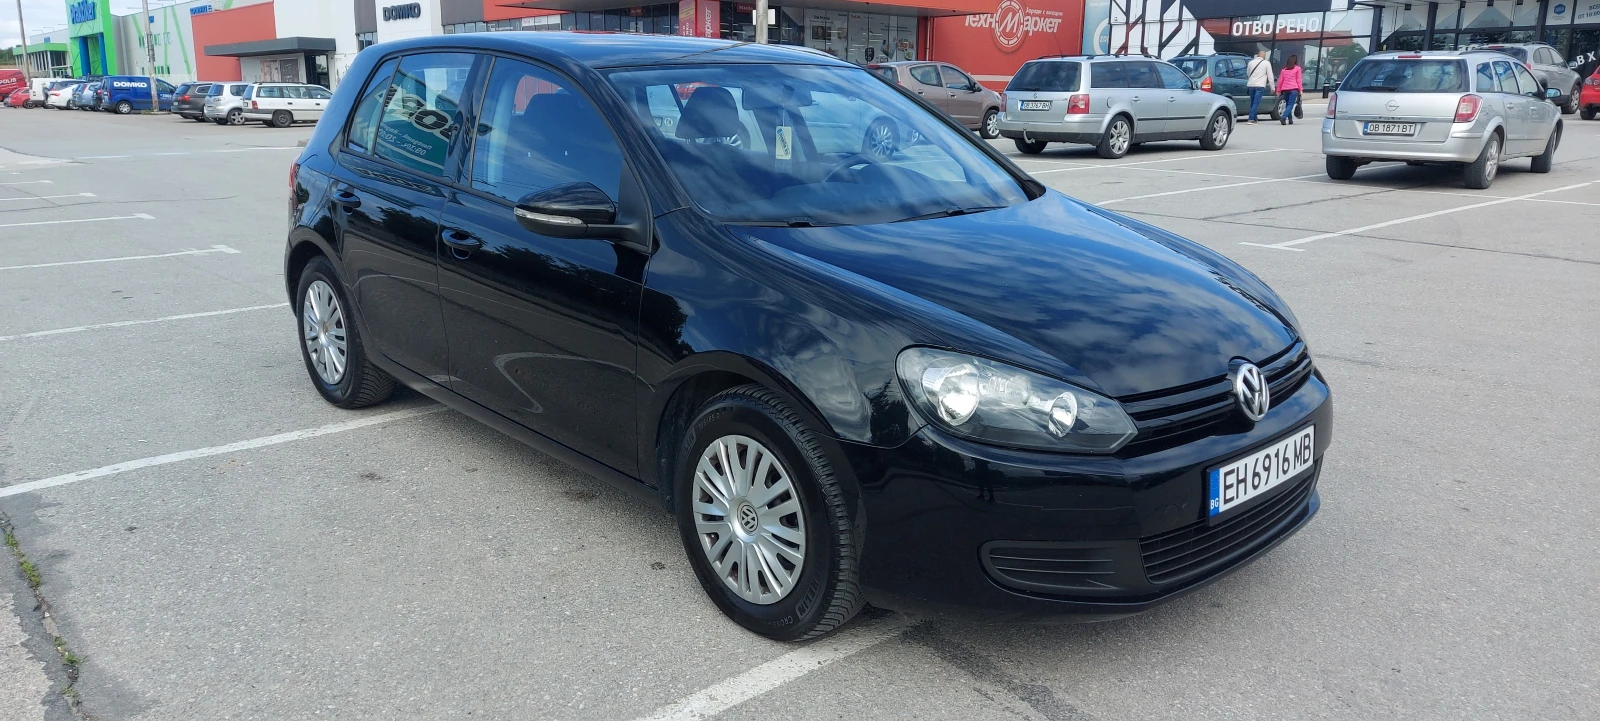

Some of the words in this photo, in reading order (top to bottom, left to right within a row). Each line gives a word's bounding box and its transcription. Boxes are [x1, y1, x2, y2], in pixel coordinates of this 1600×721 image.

[383, 2, 421, 21] DOMKO
[1232, 17, 1320, 36] ОТВОРЕНО
[1382, 124, 1400, 132] 1871
[1402, 125, 1414, 133] BT
[1223, 463, 1248, 506] EH
[1252, 443, 1290, 491] 6916
[1293, 432, 1311, 470] MB
[1210, 497, 1219, 510] BG
